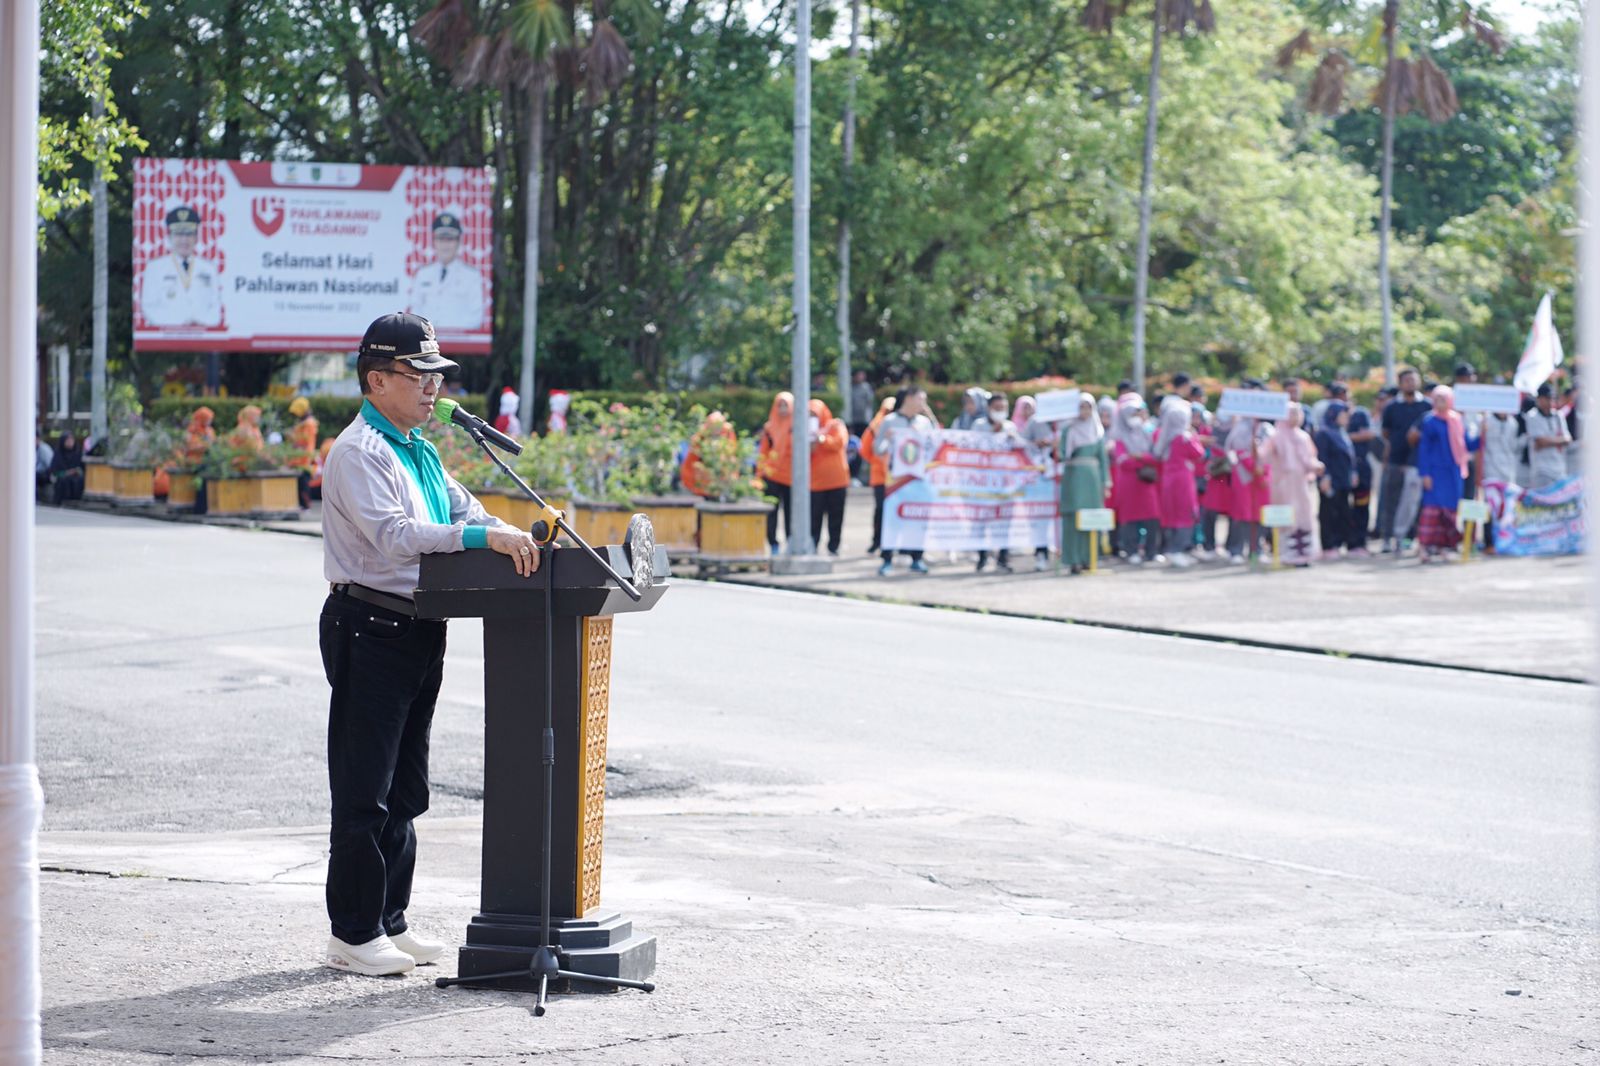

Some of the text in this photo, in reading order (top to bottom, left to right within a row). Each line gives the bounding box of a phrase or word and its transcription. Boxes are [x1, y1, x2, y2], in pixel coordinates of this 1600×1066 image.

[262, 252, 372, 269] Selamat Hari
[235, 276, 398, 294] Pahlawan Nasional
